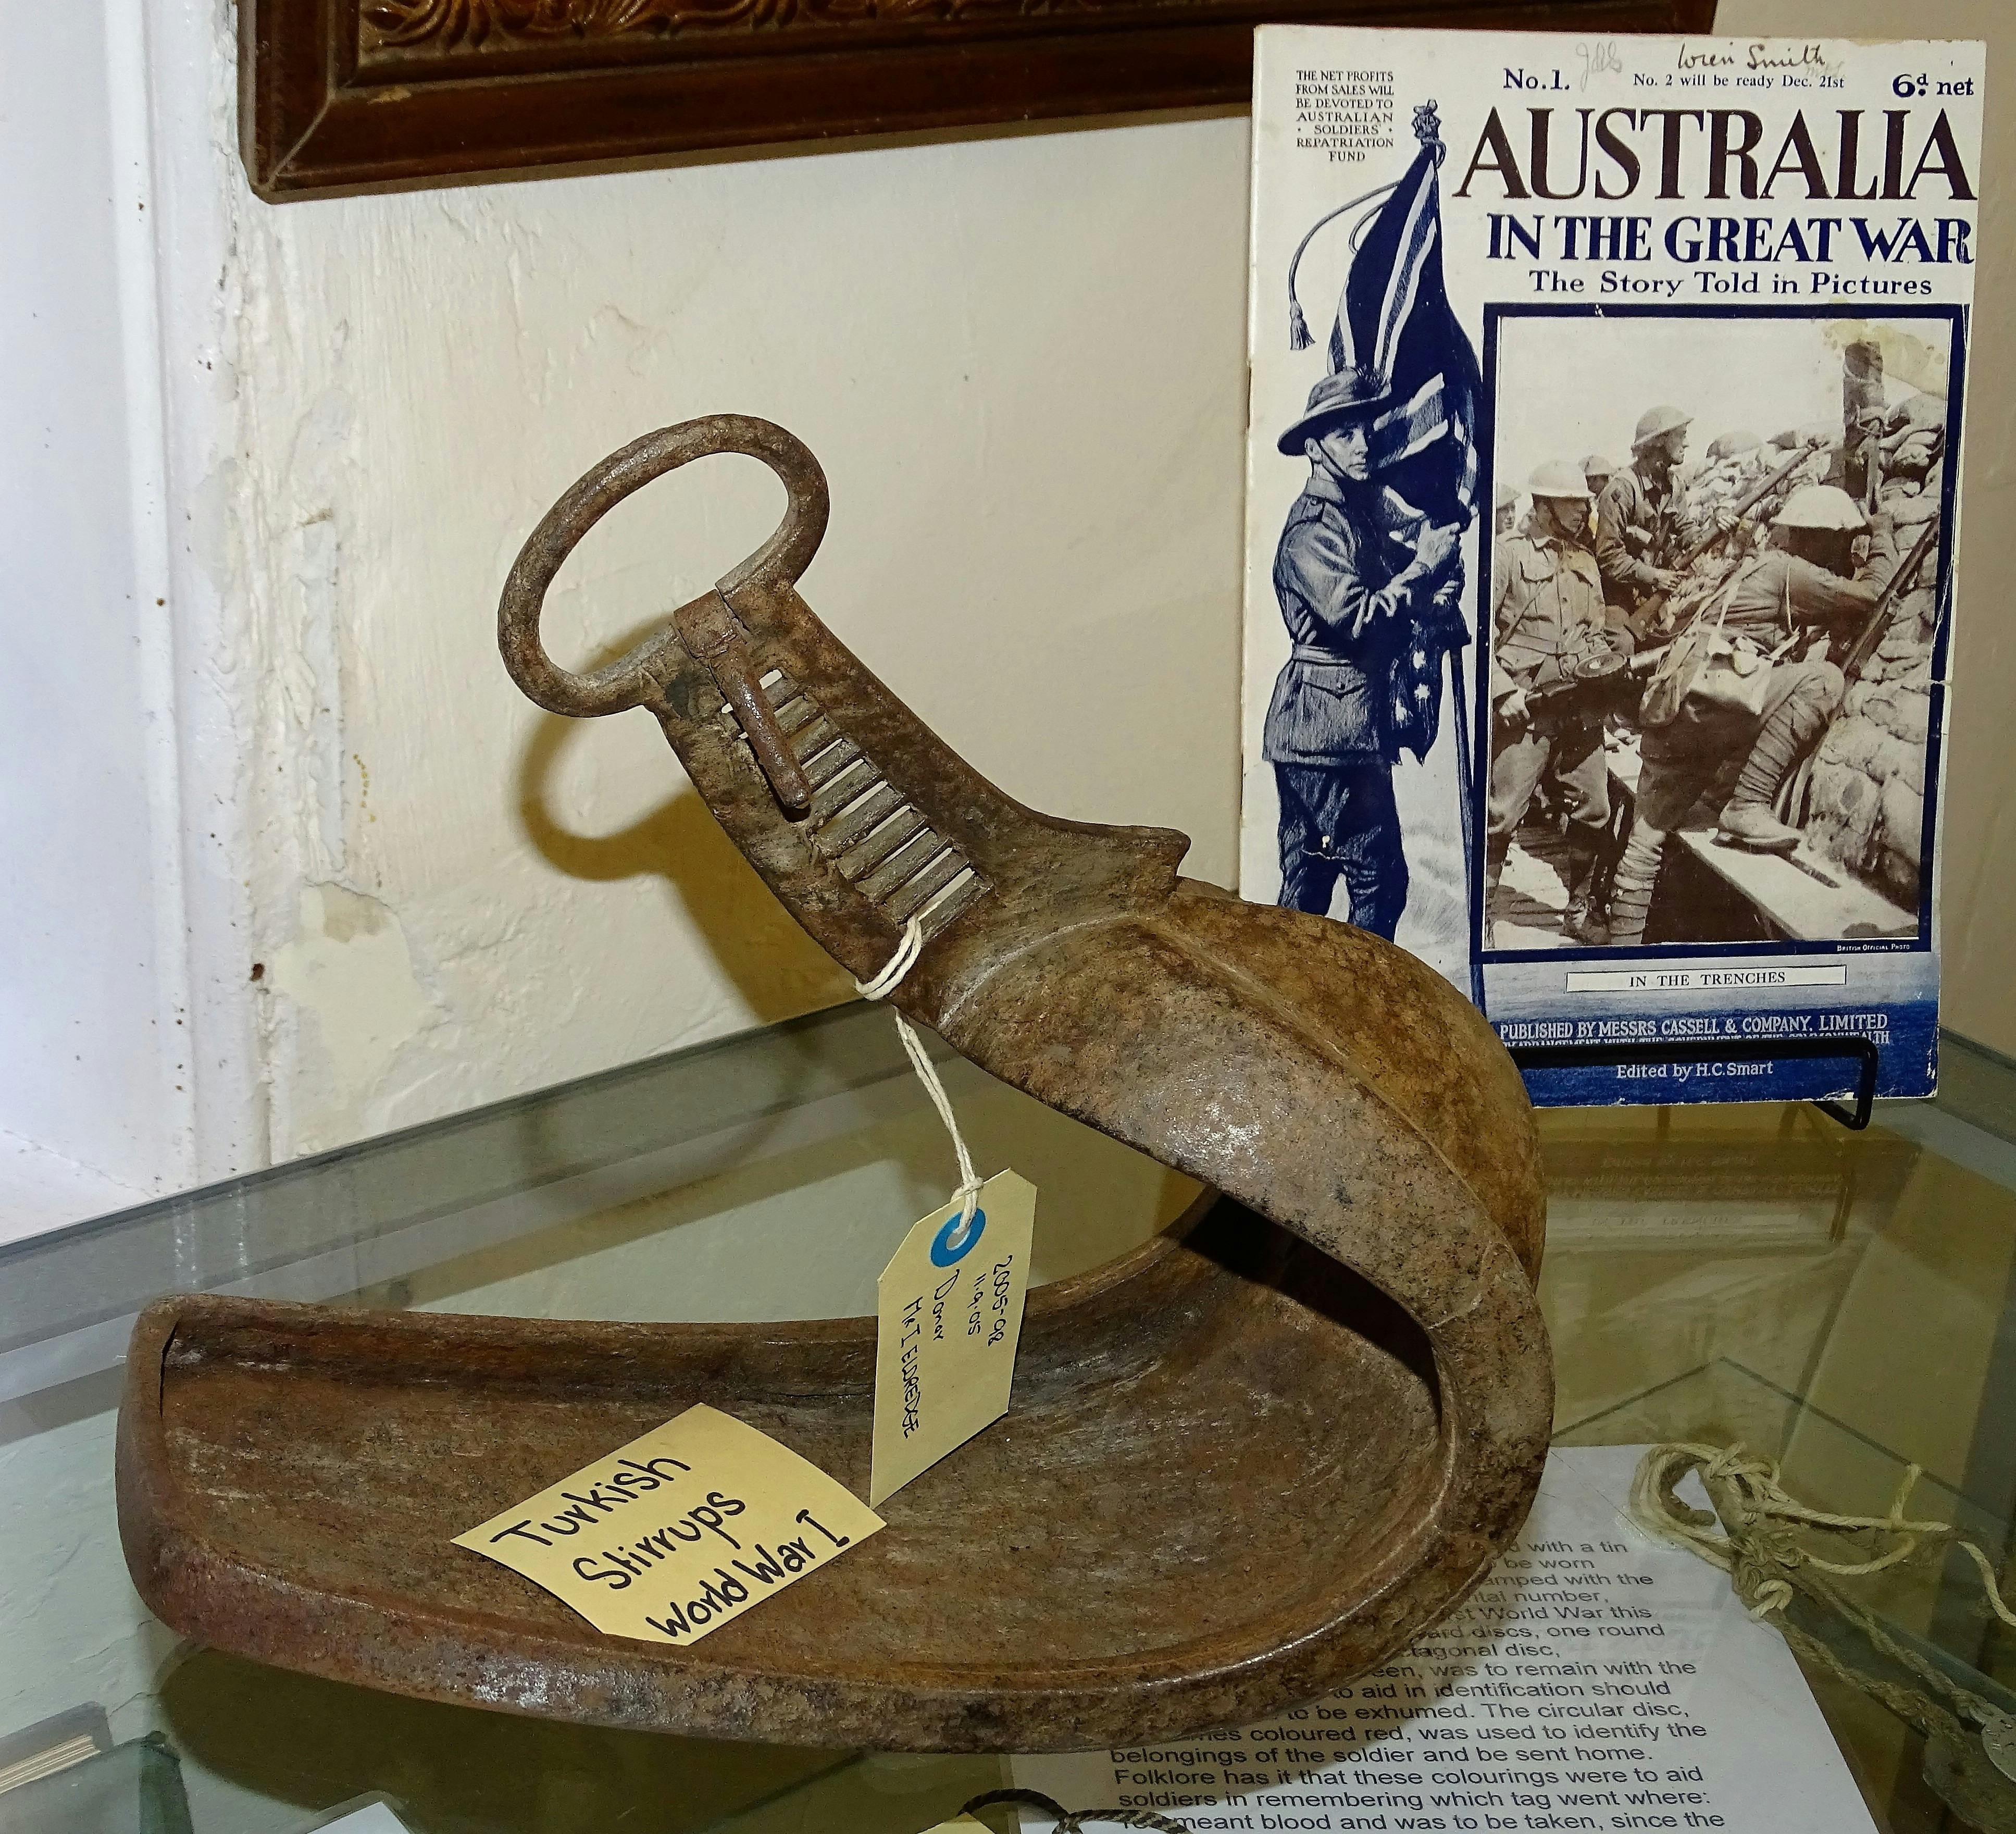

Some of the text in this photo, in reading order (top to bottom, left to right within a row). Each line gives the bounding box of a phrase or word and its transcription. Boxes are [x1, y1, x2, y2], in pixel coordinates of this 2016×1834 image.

[1296, 70, 1394, 82] THE NET PROFITS
[1633, 73, 1845, 88] No. 2 will be ready Dec. 21st
[1296, 83, 1395, 95] FROM SALES WILL
[1937, 78, 1974, 96] net
[1296, 97, 1393, 108] BE DEVOTED TO
[1296, 111, 1393, 122] AUSTRALIAN
[1296, 137, 1394, 147] REPATRIATION
[1328, 151, 1365, 162] FUND
[1452, 106, 1978, 202] AUSTRALIA
[1486, 213, 1975, 266] IN THE GREAT WAR
[1529, 270, 1933, 297] The Story Told in Pictures
[1629, 972, 1786, 987] IN THE TRENCHES
[1500, 1022, 1573, 1040] PUBLISHED
[1576, 1022, 1597, 1037] BY
[1598, 1020, 1657, 1037] MESSRS
[1661, 1017, 1720, 1035] CASSELL
[1725, 1019, 1737, 1033] &
[1819, 1014, 1888, 1031] LIMITED
[1616, 1063, 1667, 1079] Edited
[1672, 1062, 1694, 1083] by
[932, 1269, 961, 1341] Donor
[490, 1457, 692, 1546] Turkish
[573, 1491, 747, 1590] Stirrups
[1528, 1541, 1573, 1553] with
[1581, 1543, 1595, 1553] a
[1600, 1541, 1628, 1553] tin
[1504, 1558, 1596, 1569] be worn
[645, 1509, 850, 1638] World War I
[1485, 1573, 1654, 1588] amped with the
[1514, 1590, 1609, 1603] number,
[1478, 1606, 1549, 1619] World
[1554, 1607, 1602, 1619] War
[1610, 1606, 1652, 1619] this
[1472, 1625, 1540, 1639] discs,
[1547, 1627, 1590, 1637] one
[1598, 1624, 1665, 1637] round
[1505, 1643, 1561, 1658] disc,
[1430, 1665, 1478, 1676] was
[1485, 1663, 1509, 1676] to
[1515, 1662, 1598, 1676] remain
[1603, 1661, 1652, 1675] with
[1659, 1660, 1697, 1675] the
[1362, 1683, 1397, 1698] aid
[1405, 1683, 1426, 1698] in
[1435, 1682, 1584, 1697] identification
[1592, 1681, 1671, 1696] should
[1316, 1705, 1348, 1720] be
[1355, 1703, 1475, 1719] exhumed.
[1480, 1703, 1530, 1718] The
[1538, 1702, 1625, 1718] circular
[1633, 1701, 1689, 1718] disc,
[1250, 1726, 1356, 1741] coloured
[1365, 1726, 1411, 1743] red,
[1418, 1727, 1470, 1741] was
[1476, 1725, 1536, 1740] used
[1541, 1725, 1566, 1739] to
[1573, 1723, 1660, 1741] identify
[1667, 1722, 1708, 1737] the
[1111, 1745, 1653, 1766] belongings of the soldier and be sent home.
[1115, 1766, 1704, 1787] Folklore has it that these colourings were to aid
[1118, 1790, 1711, 1811] soldiers in remembering which tag went where:
[1174, 1812, 1725, 1831] meant blood and was to be taken, since the
